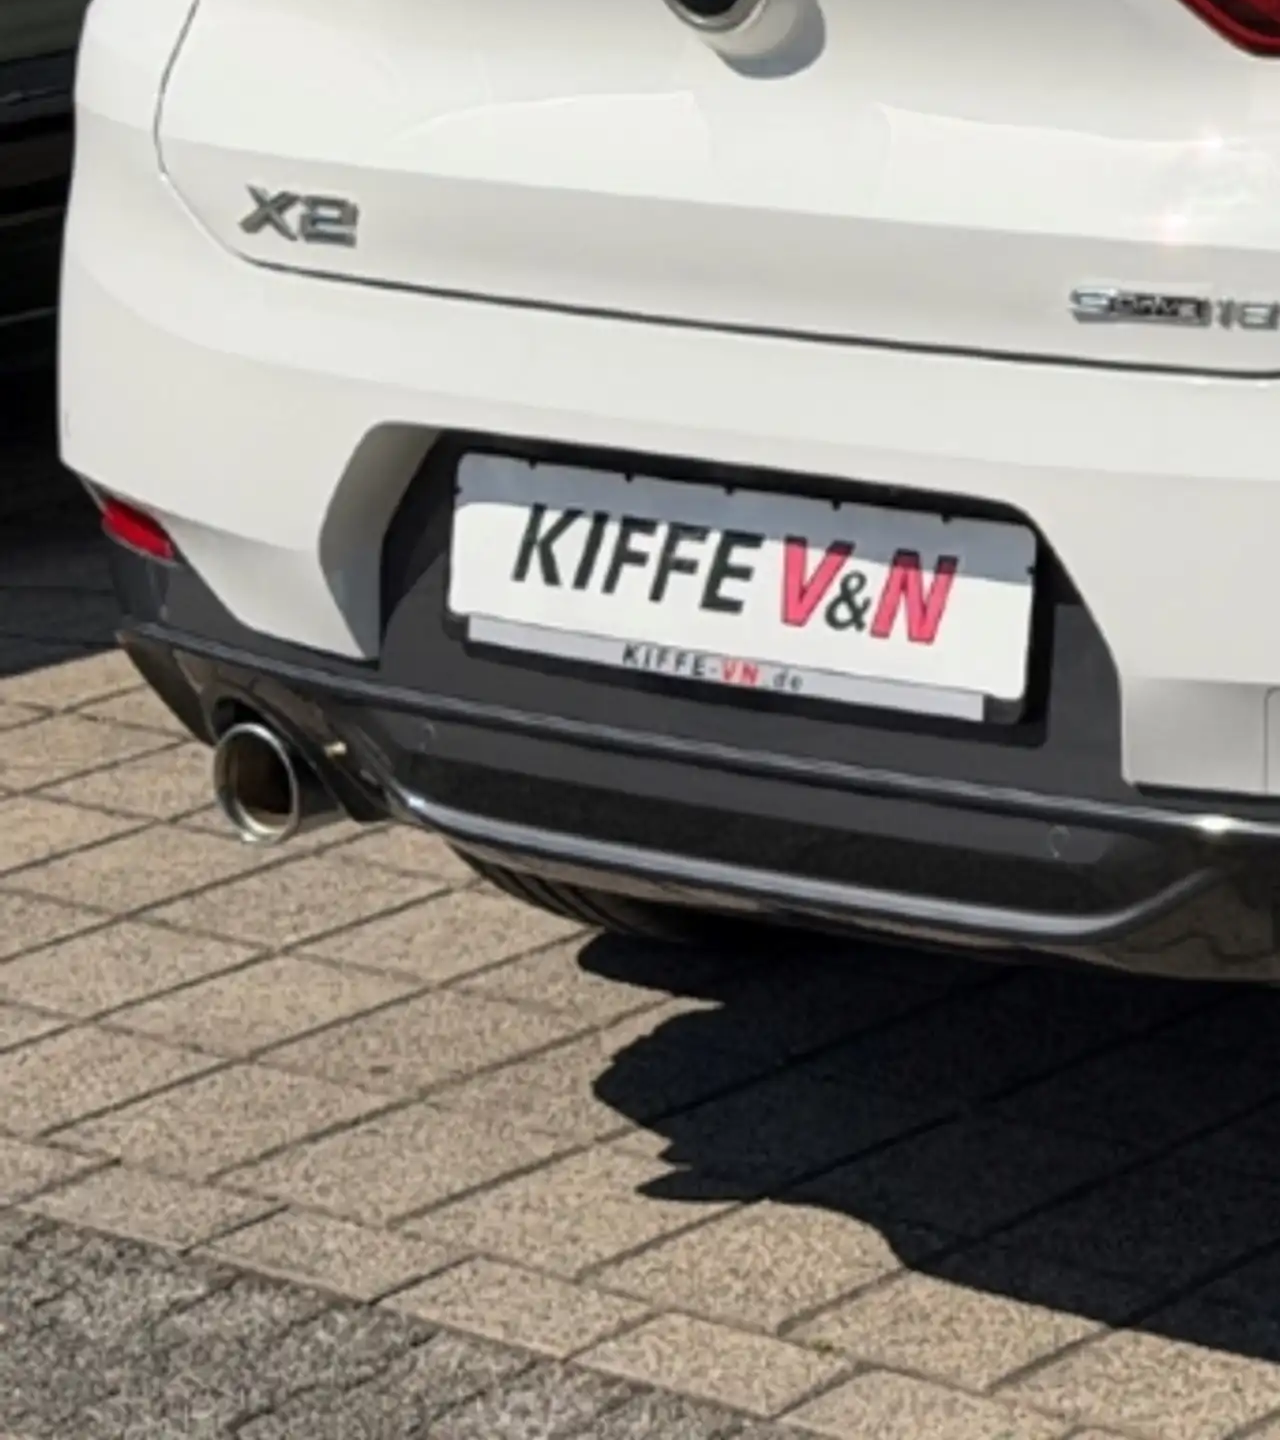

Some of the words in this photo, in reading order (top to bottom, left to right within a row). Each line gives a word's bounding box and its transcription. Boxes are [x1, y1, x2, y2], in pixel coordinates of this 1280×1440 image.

[238, 183, 359, 249] X2
[511, 503, 765, 614] KIFFE
[779, 535, 958, 645] V&N
